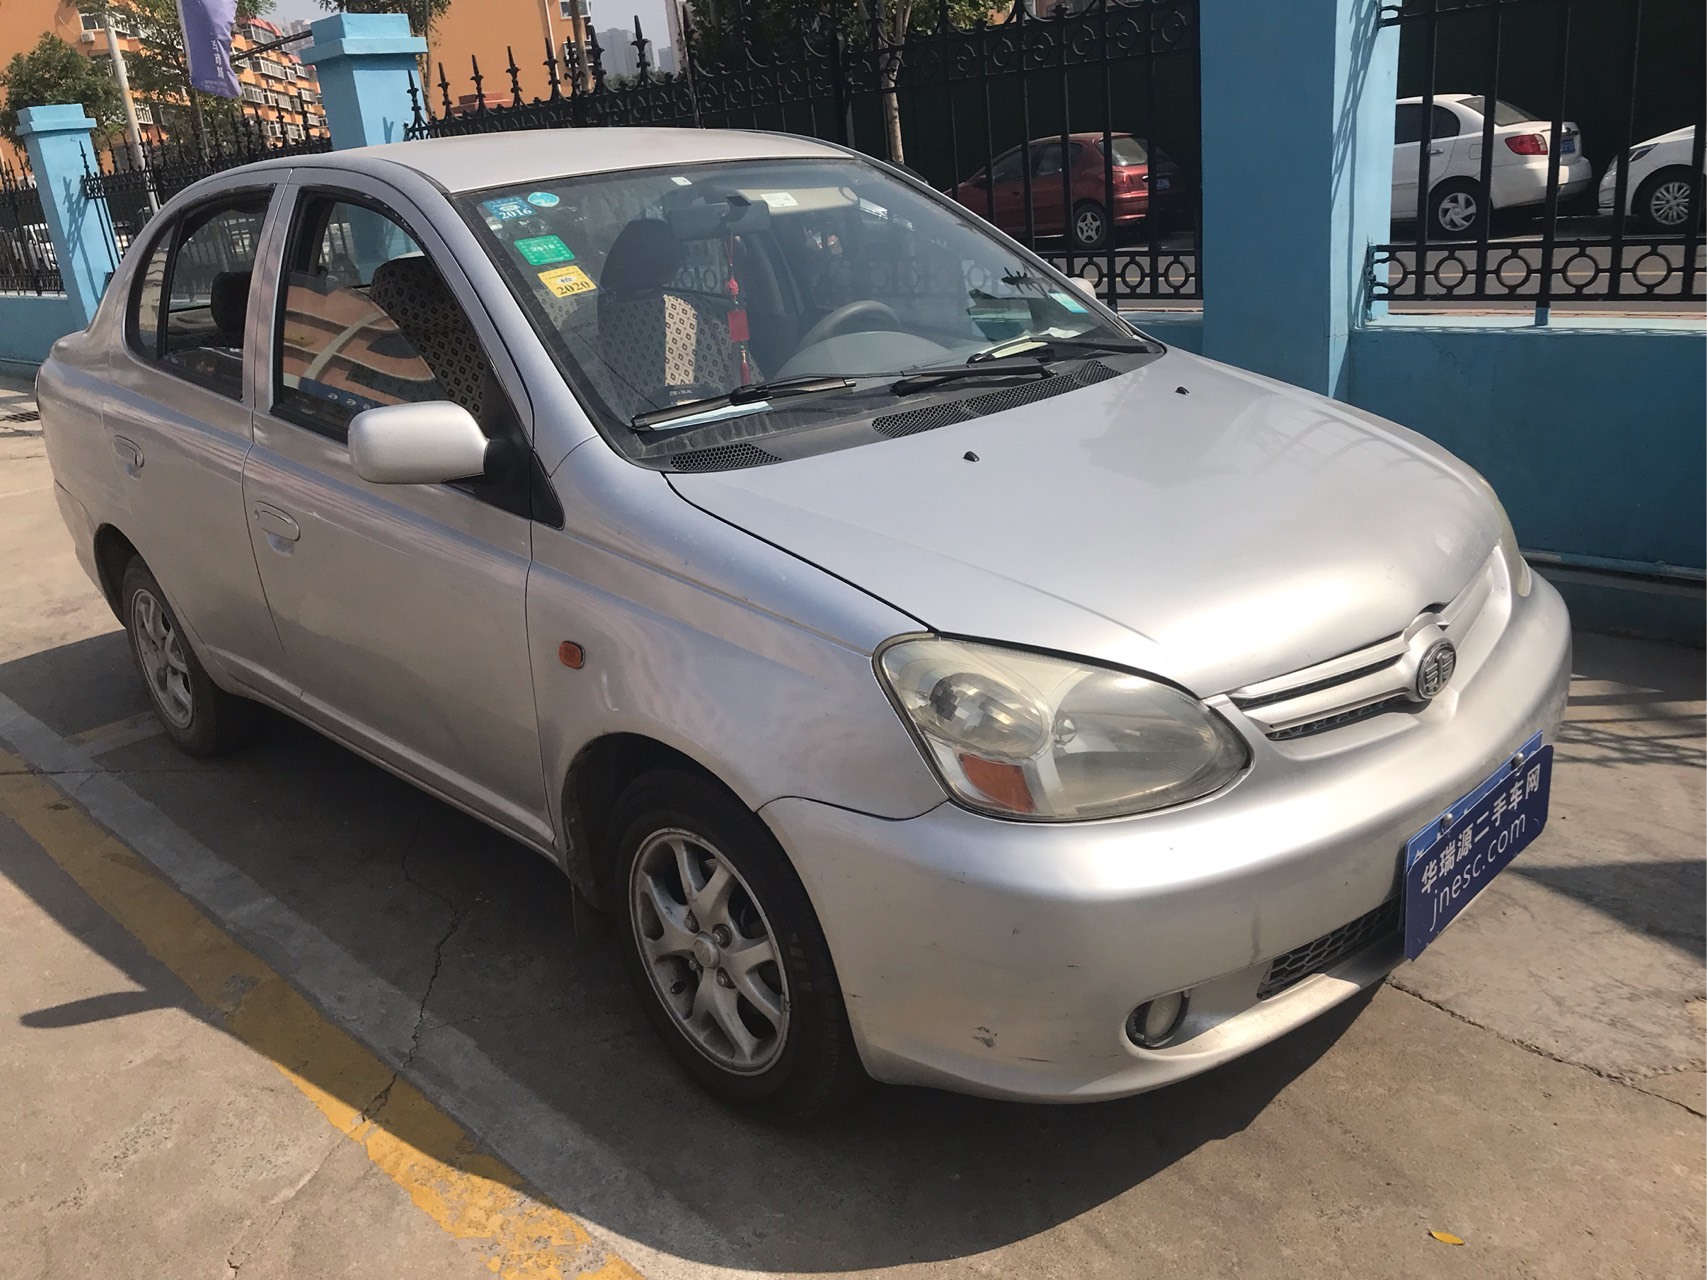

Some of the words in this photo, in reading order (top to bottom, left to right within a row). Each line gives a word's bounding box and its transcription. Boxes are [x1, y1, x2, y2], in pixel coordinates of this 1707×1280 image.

[498, 207, 532, 219] 2016
[556, 280, 590, 295] 2020
[1421, 763, 1541, 893] 华瑞源二手车网
[1429, 813, 1526, 932] jnesc.com
